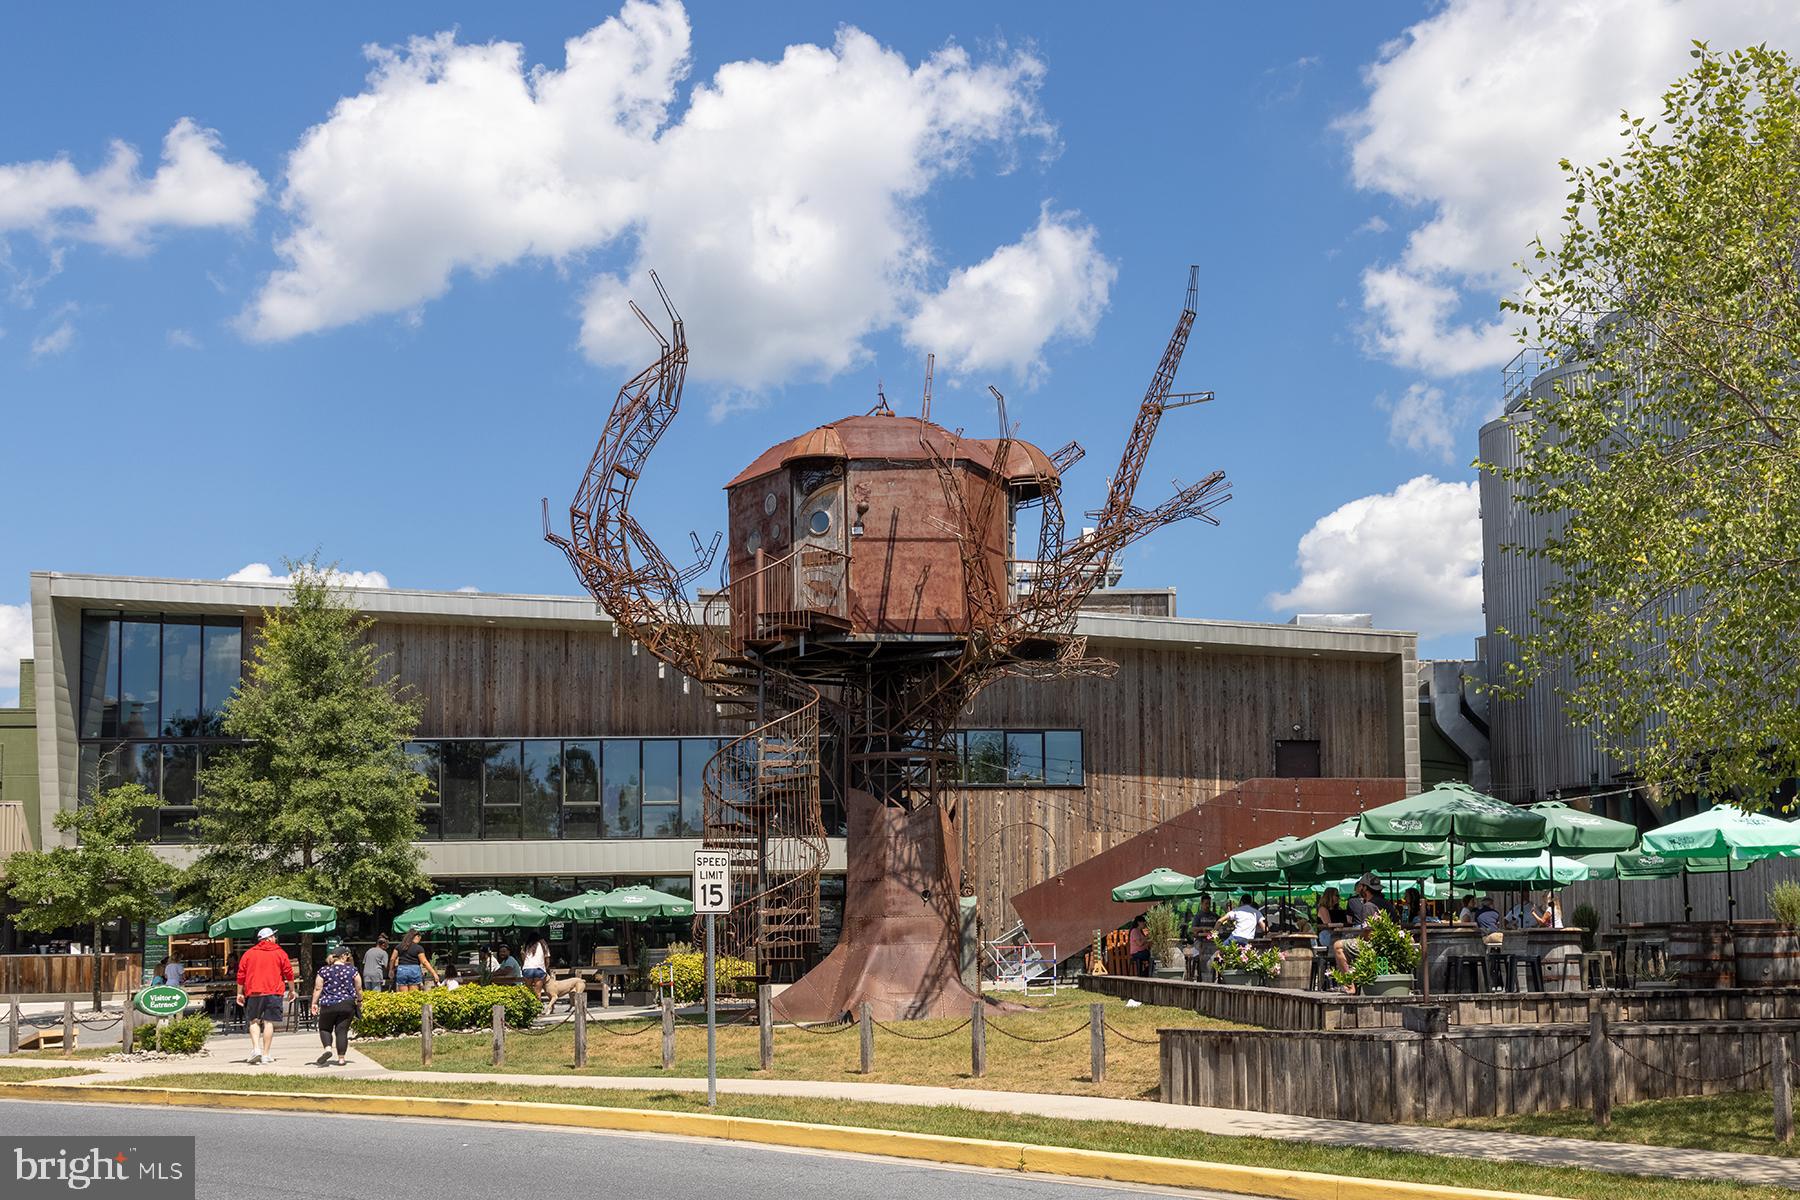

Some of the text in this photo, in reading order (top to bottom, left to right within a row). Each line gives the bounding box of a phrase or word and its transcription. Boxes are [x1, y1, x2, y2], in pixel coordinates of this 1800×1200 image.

[697, 857, 727, 866] SPEED
[700, 871, 723, 879] LIMIT
[701, 884, 723, 906] 15
